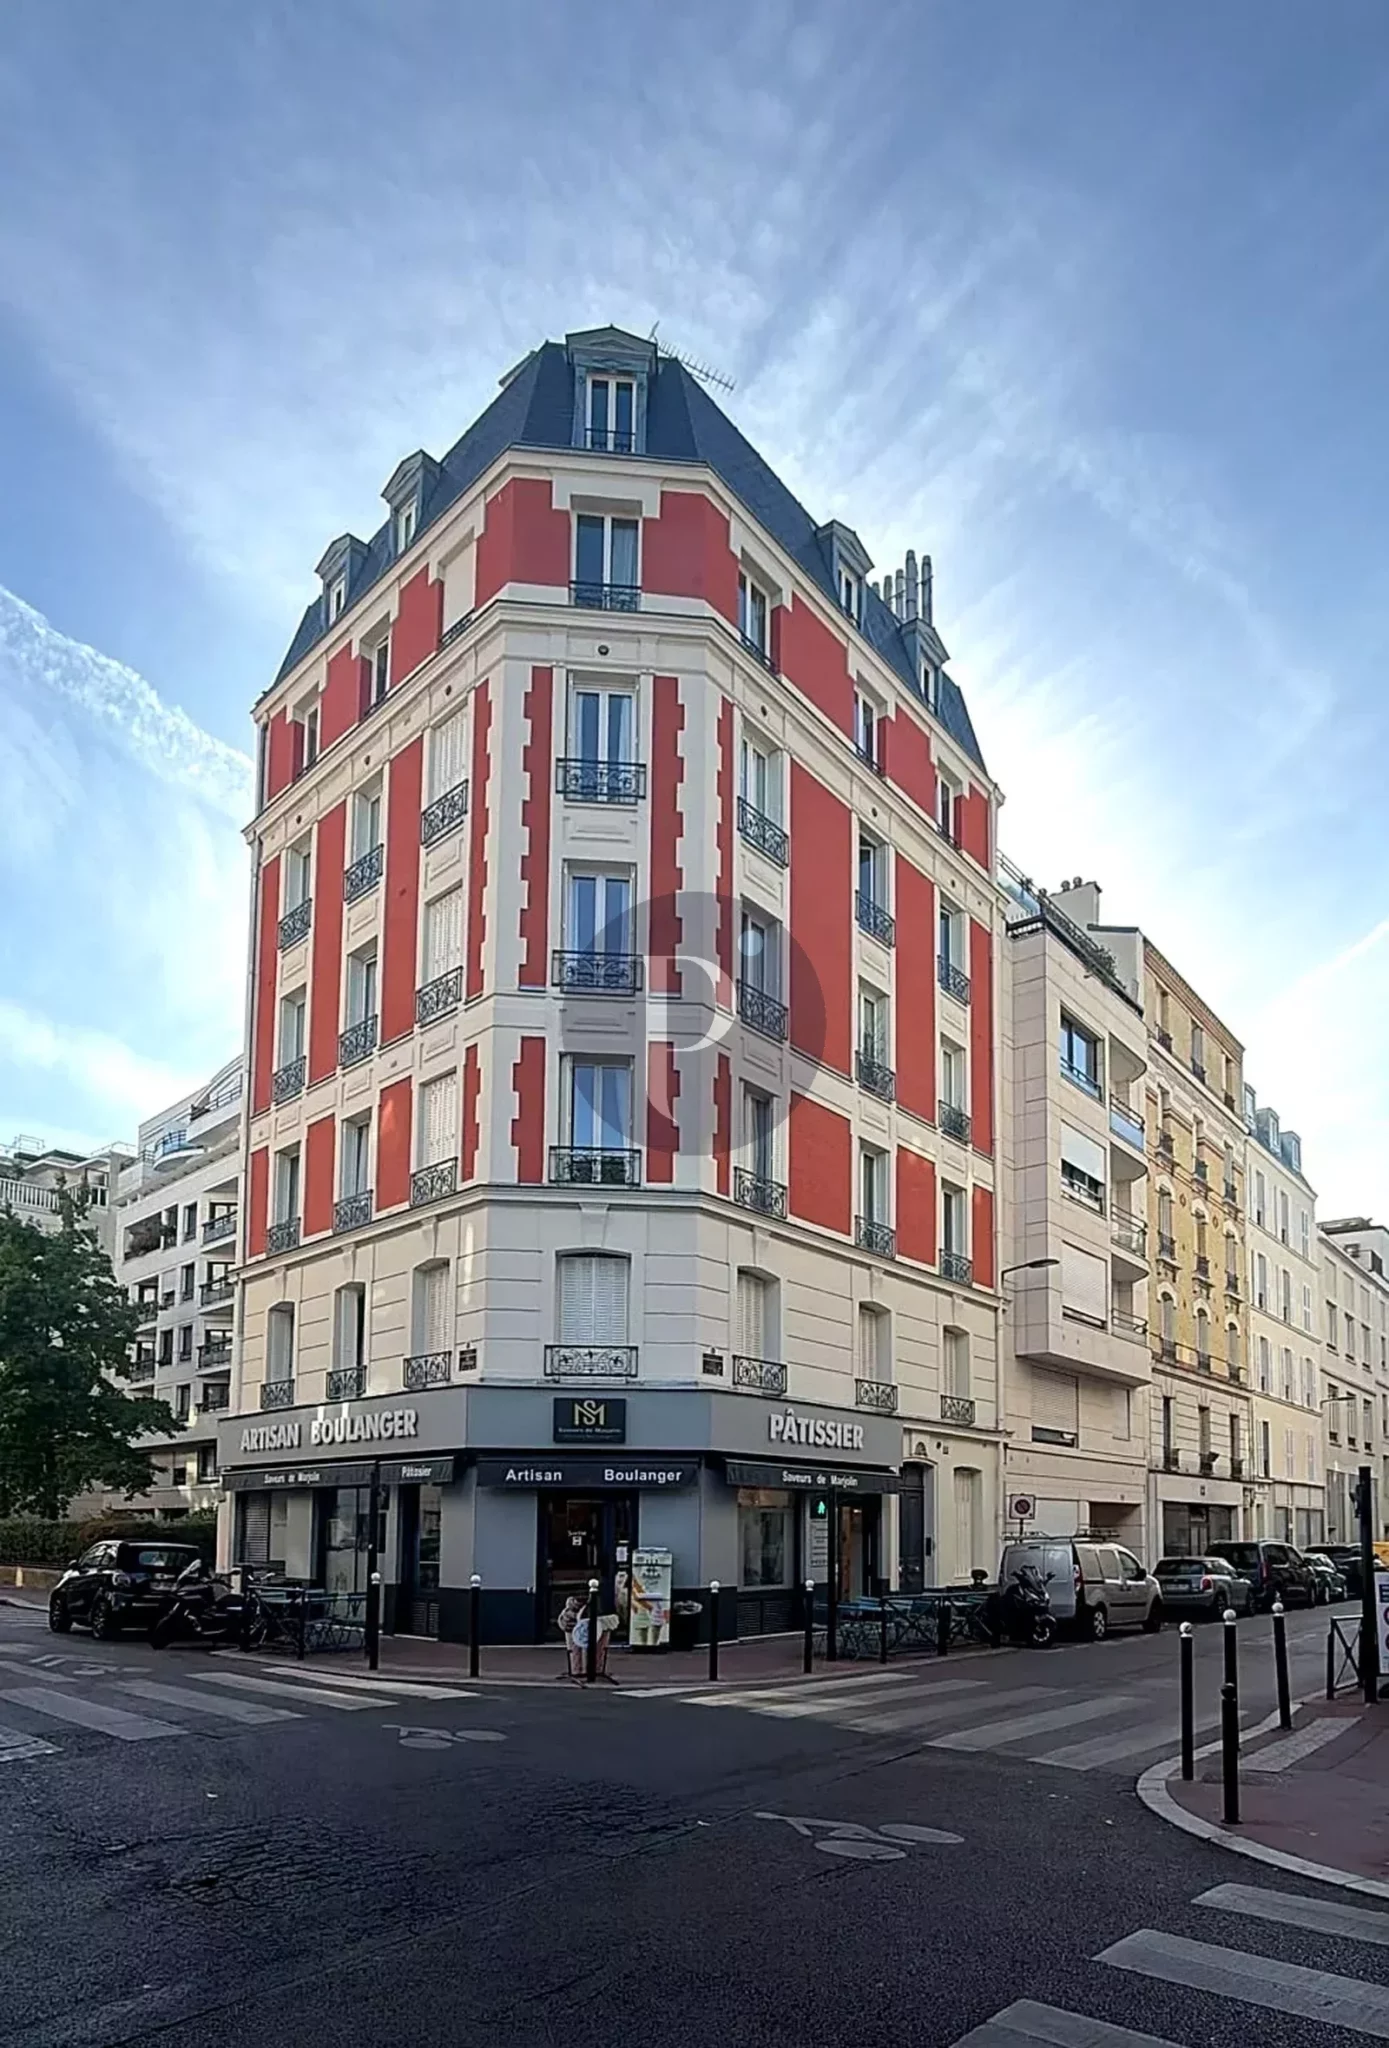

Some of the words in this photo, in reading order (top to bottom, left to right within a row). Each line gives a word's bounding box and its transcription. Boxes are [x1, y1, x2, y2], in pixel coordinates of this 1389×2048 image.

[240, 1423, 300, 1451] ARTISAN
[311, 1408, 417, 1446] BOULANGER
[769, 1407, 864, 1449] PÂTISSIER
[505, 1468, 563, 1482] Artisan
[603, 1468, 683, 1485] Boulanger
[782, 1470, 812, 1485] Saveurs
[816, 1473, 827, 1485] de
